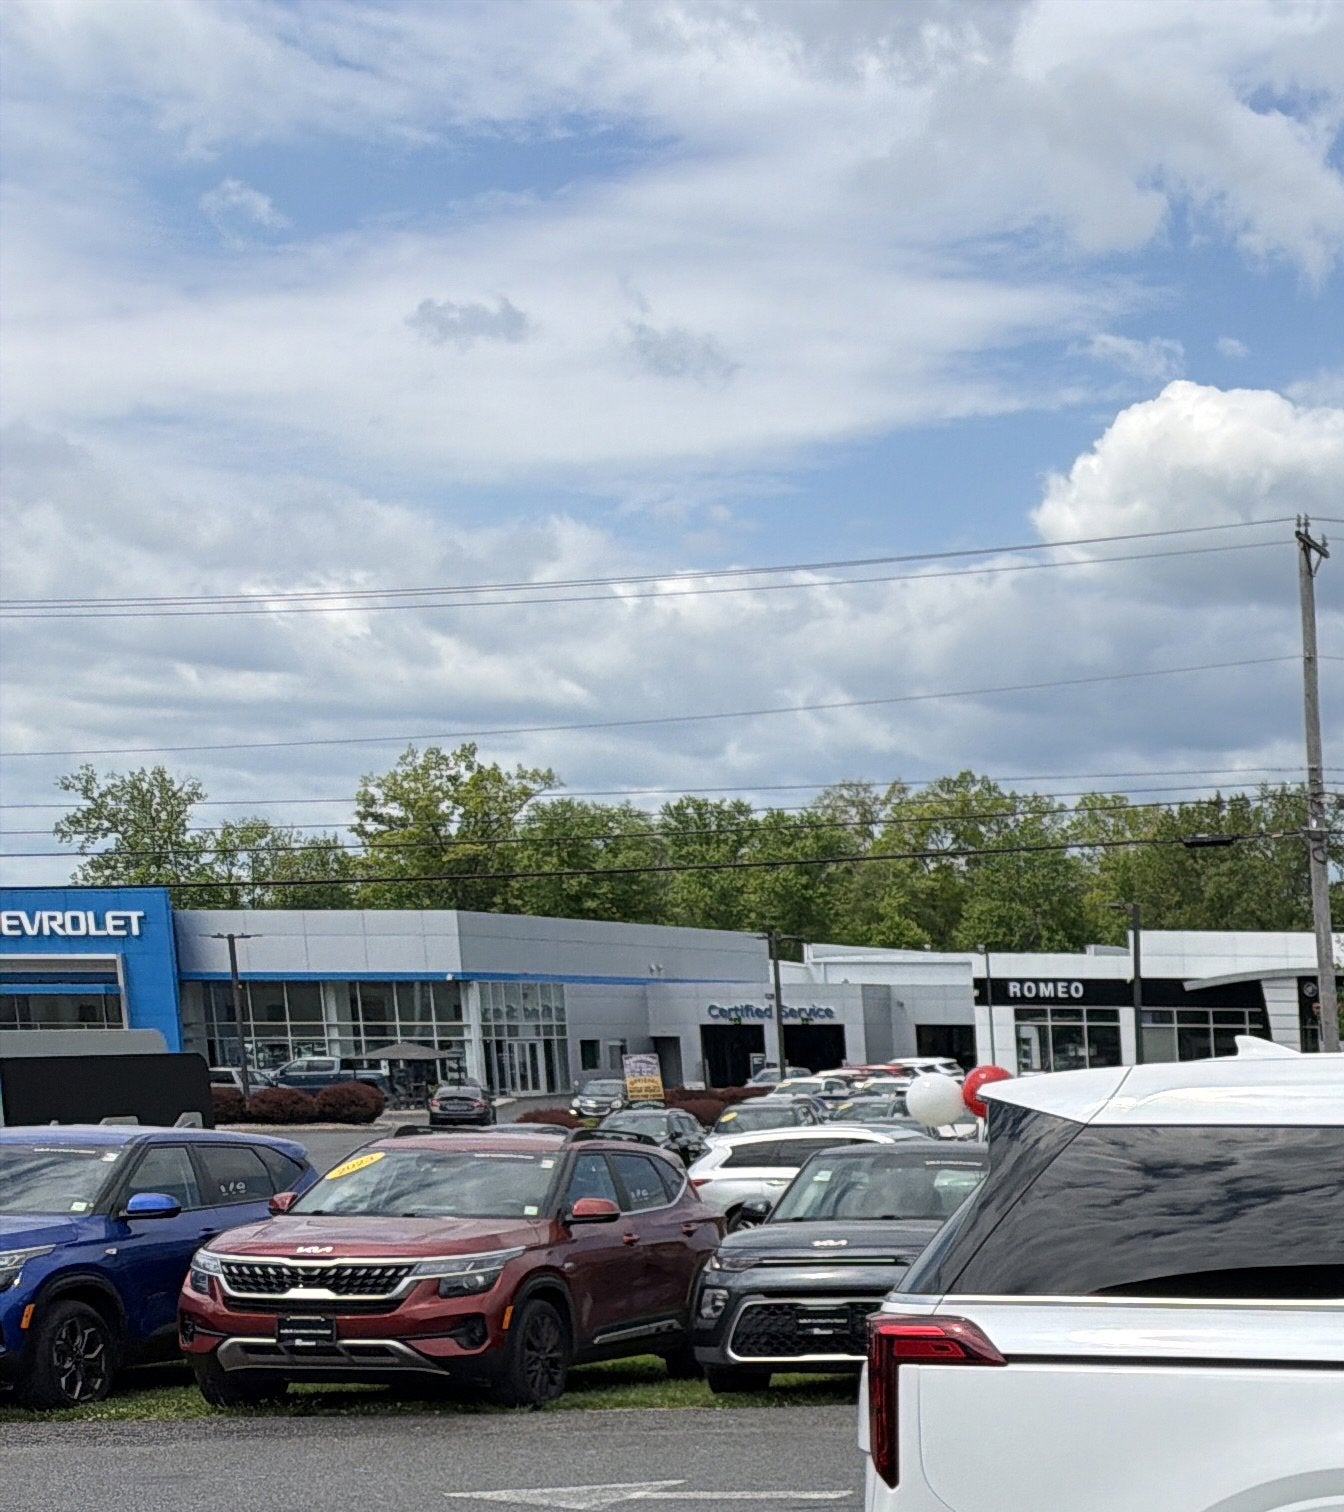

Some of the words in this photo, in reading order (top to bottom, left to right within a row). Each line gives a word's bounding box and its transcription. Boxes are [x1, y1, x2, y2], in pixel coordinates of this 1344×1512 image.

[0, 910, 145, 936] EVROLET
[1008, 981, 1084, 998] ROMEO
[708, 1004, 773, 1019] Certified
[781, 1004, 835, 1019] Service
